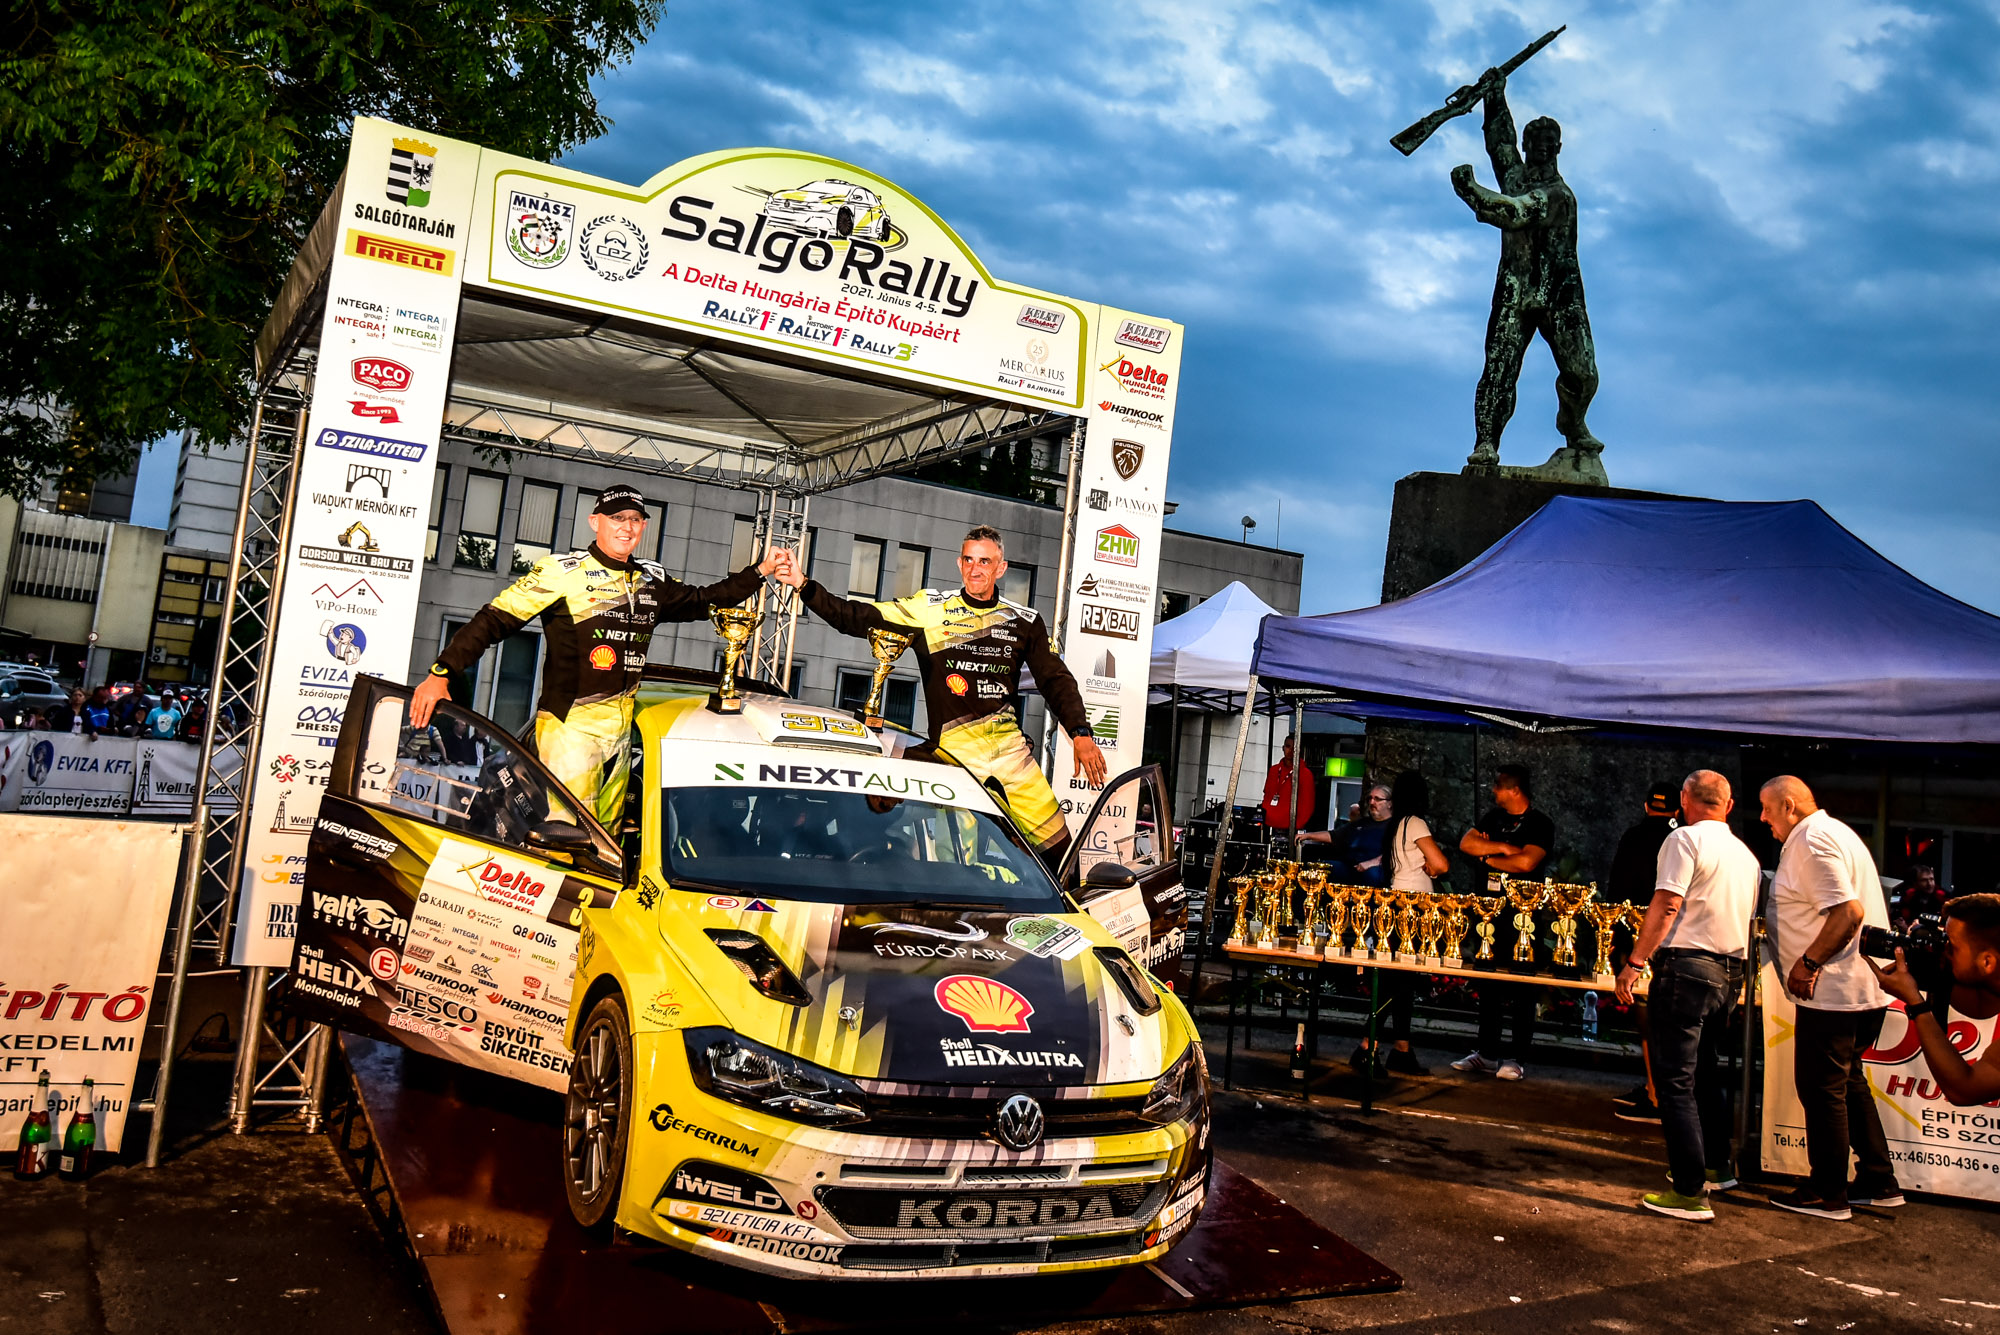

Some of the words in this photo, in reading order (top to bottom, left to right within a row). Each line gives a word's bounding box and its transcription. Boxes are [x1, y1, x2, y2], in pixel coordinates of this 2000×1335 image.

[354, 203, 456, 239] SALGÓTARJÁN
[355, 235, 446, 271] PIRELLI
[661, 195, 835, 274] Salgó
[838, 237, 979, 318] Rally
[603, 270, 619, 282] 25
[337, 296, 383, 313] INTEGRA
[661, 262, 679, 281] A
[683, 266, 738, 293] Delta
[741, 279, 831, 314] Hungária
[887, 313, 961, 343] Kupáért
[840, 282, 875, 301] 2021.
[876, 290, 911, 308] Június
[914, 300, 938, 314] 4-5.
[363, 311, 383, 321] group
[396, 308, 440, 325] INTEGRA
[744, 306, 762, 315] ORC
[1025, 306, 1061, 323] KELET
[393, 325, 437, 341] INTEGRA
[806, 320, 834, 331] HISTORIC
[1124, 322, 1165, 341] KELET
[1032, 344, 1043, 355] 25
[359, 362, 406, 383] PACO
[999, 357, 1065, 381] MERCARIUS
[1118, 359, 1168, 387] Delta
[1122, 378, 1165, 394] HUNGÁRIA
[338, 434, 424, 460] SZILA-SYSTEM
[1115, 441, 1142, 451] PEUGEOT
[312, 492, 354, 510] VIADUKT
[399, 506, 418, 519] KFT
[1097, 533, 1138, 557] ZHW
[300, 547, 340, 563] BORSOD
[342, 550, 368, 565] WELL
[370, 555, 391, 569] BAU
[1081, 605, 1139, 632] REXBAU
[944, 641, 978, 652] EFFECTIVE
[300, 665, 349, 683] EVIZA
[955, 660, 1011, 675] NEXTAUTO
[977, 681, 1010, 696] HELIX
[1085, 677, 1121, 692] enerway
[296, 721, 339, 733] PRESS
[57, 755, 99, 773] EVIZA
[104, 758, 133, 775] KFT.
[156, 781, 182, 794] Well
[759, 764, 956, 801] NEXTAUTO
[19, 791, 129, 809] zórólapterjesztés
[1076, 801, 1127, 818] KAADI
[317, 818, 399, 853] WEINSBERG
[479, 861, 545, 898] Delta
[481, 883, 536, 907] HUNGÁRIA
[312, 911, 406, 946] SECURITY
[415, 914, 442, 928] INTEGRA
[452, 926, 479, 941] INTEGRA
[300, 944, 324, 959] Shell
[873, 941, 1016, 962] FÜRDŐPARK
[378, 955, 393, 972] E
[298, 955, 378, 997] HELIX
[0, 981, 150, 1023] PÍTŐ
[294, 978, 362, 1008] Motorolajok
[396, 985, 478, 1024] TESCO
[389, 1013, 450, 1041] Biztosítás
[484, 1020, 544, 1049] EGYÜTT
[939, 1037, 973, 1051] Shell
[942, 1043, 1018, 1067] HELIX
[1016, 1051, 1085, 1068] ULTRA
[1921, 1123, 1951, 1140] ÉS
[1887, 1148, 1980, 1171] ax:46/530-436
[675, 1169, 783, 1210] iWELD
[897, 1195, 1115, 1228] KORDA
[781, 1222, 817, 1241] KFT.
